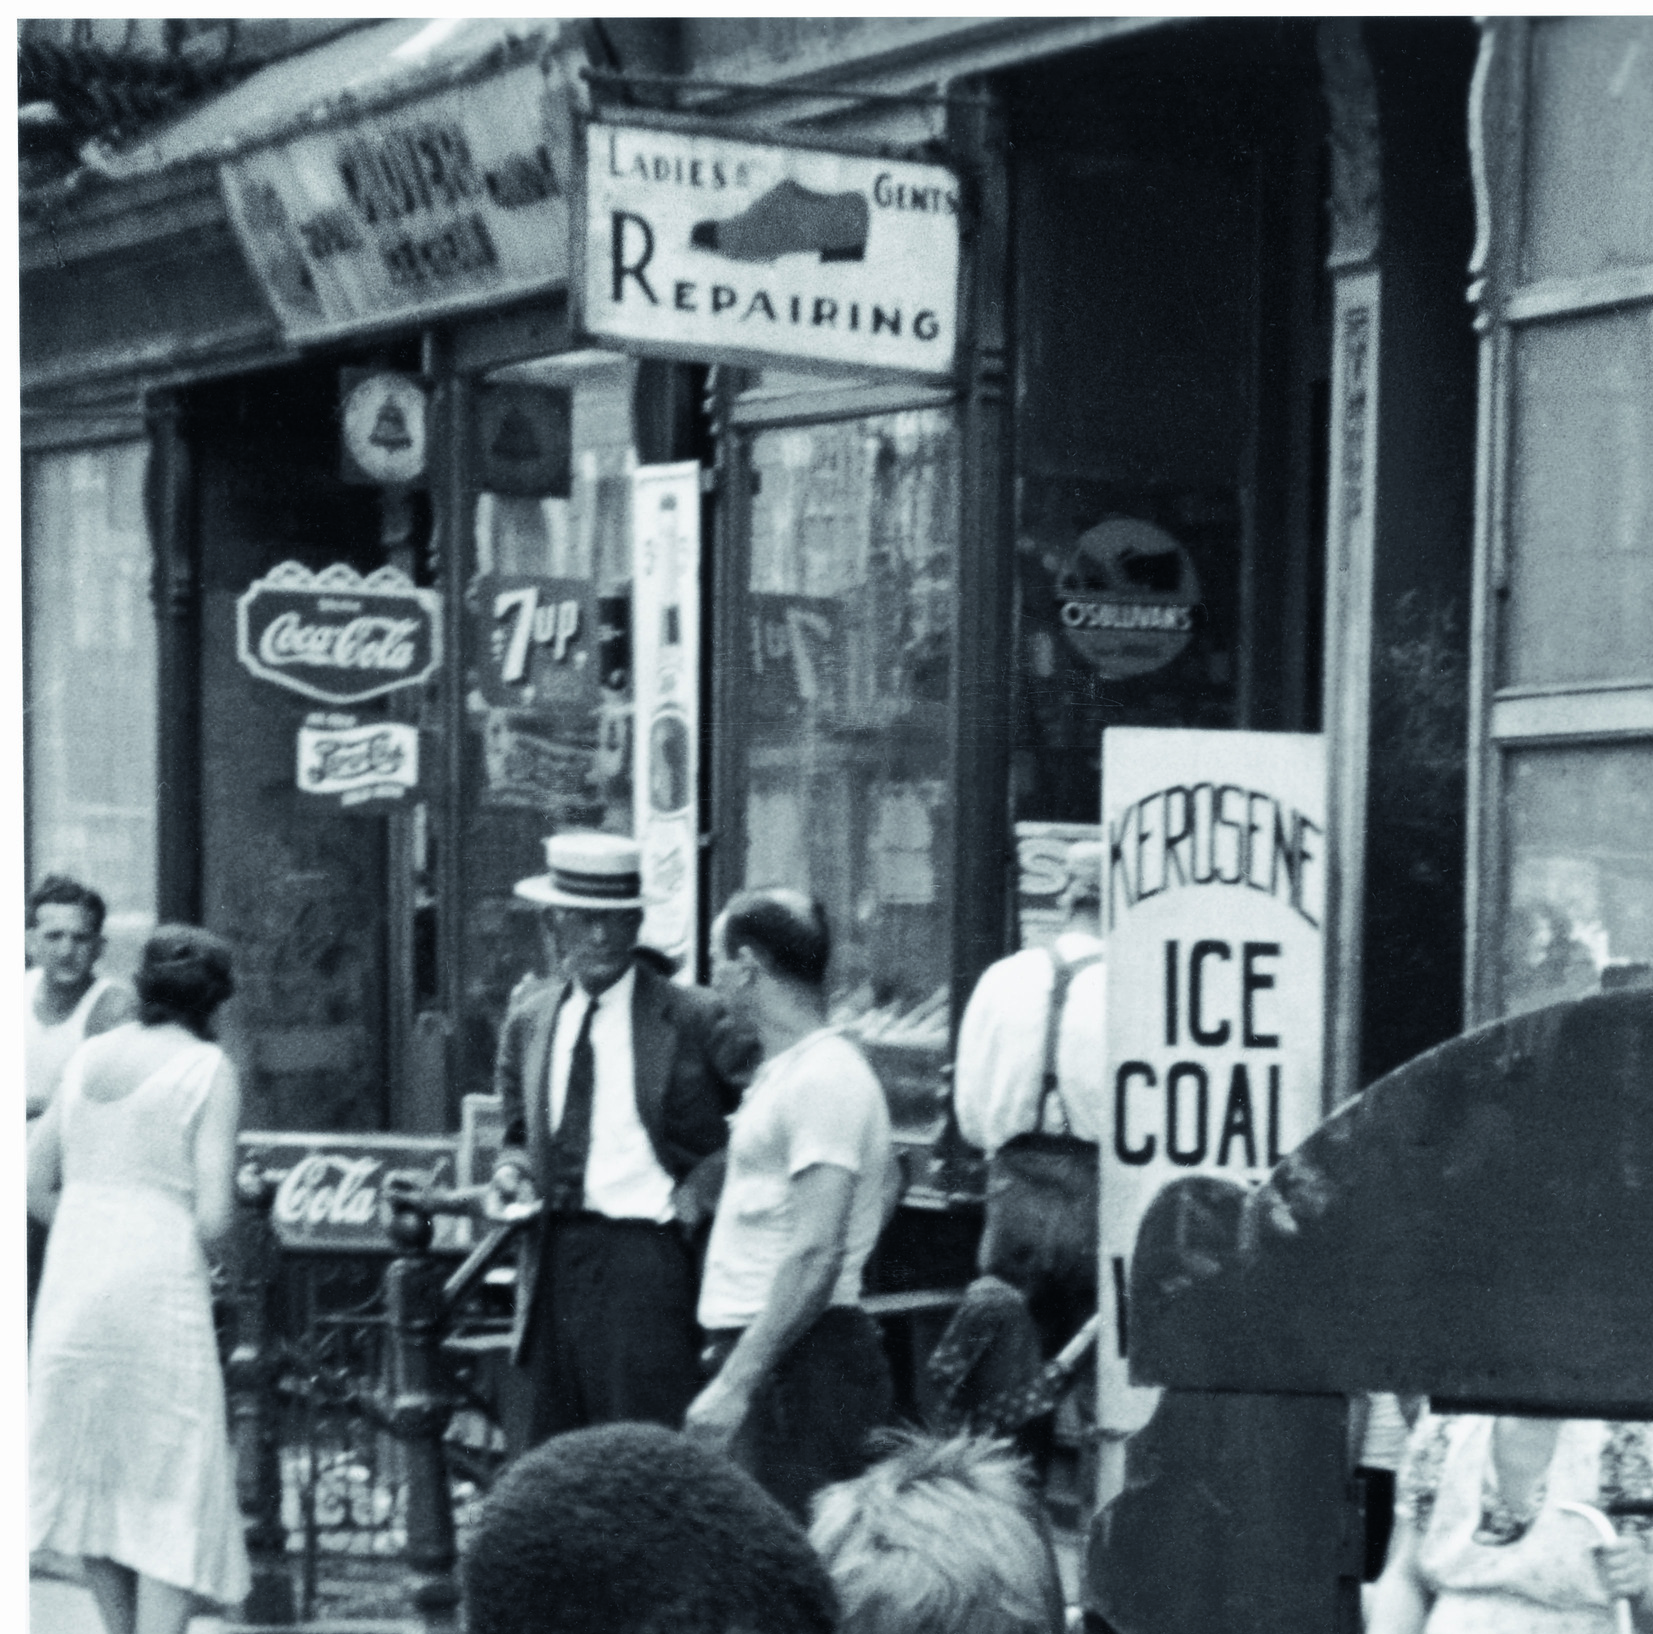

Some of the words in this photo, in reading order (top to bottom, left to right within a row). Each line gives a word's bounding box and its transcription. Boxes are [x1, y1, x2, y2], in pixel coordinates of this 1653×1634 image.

[610, 209, 941, 341] REPAIRING
[1107, 781, 1324, 934] KEROSENE
[1164, 938, 1282, 1049] ICE
[1113, 1060, 1290, 1168] COAL
